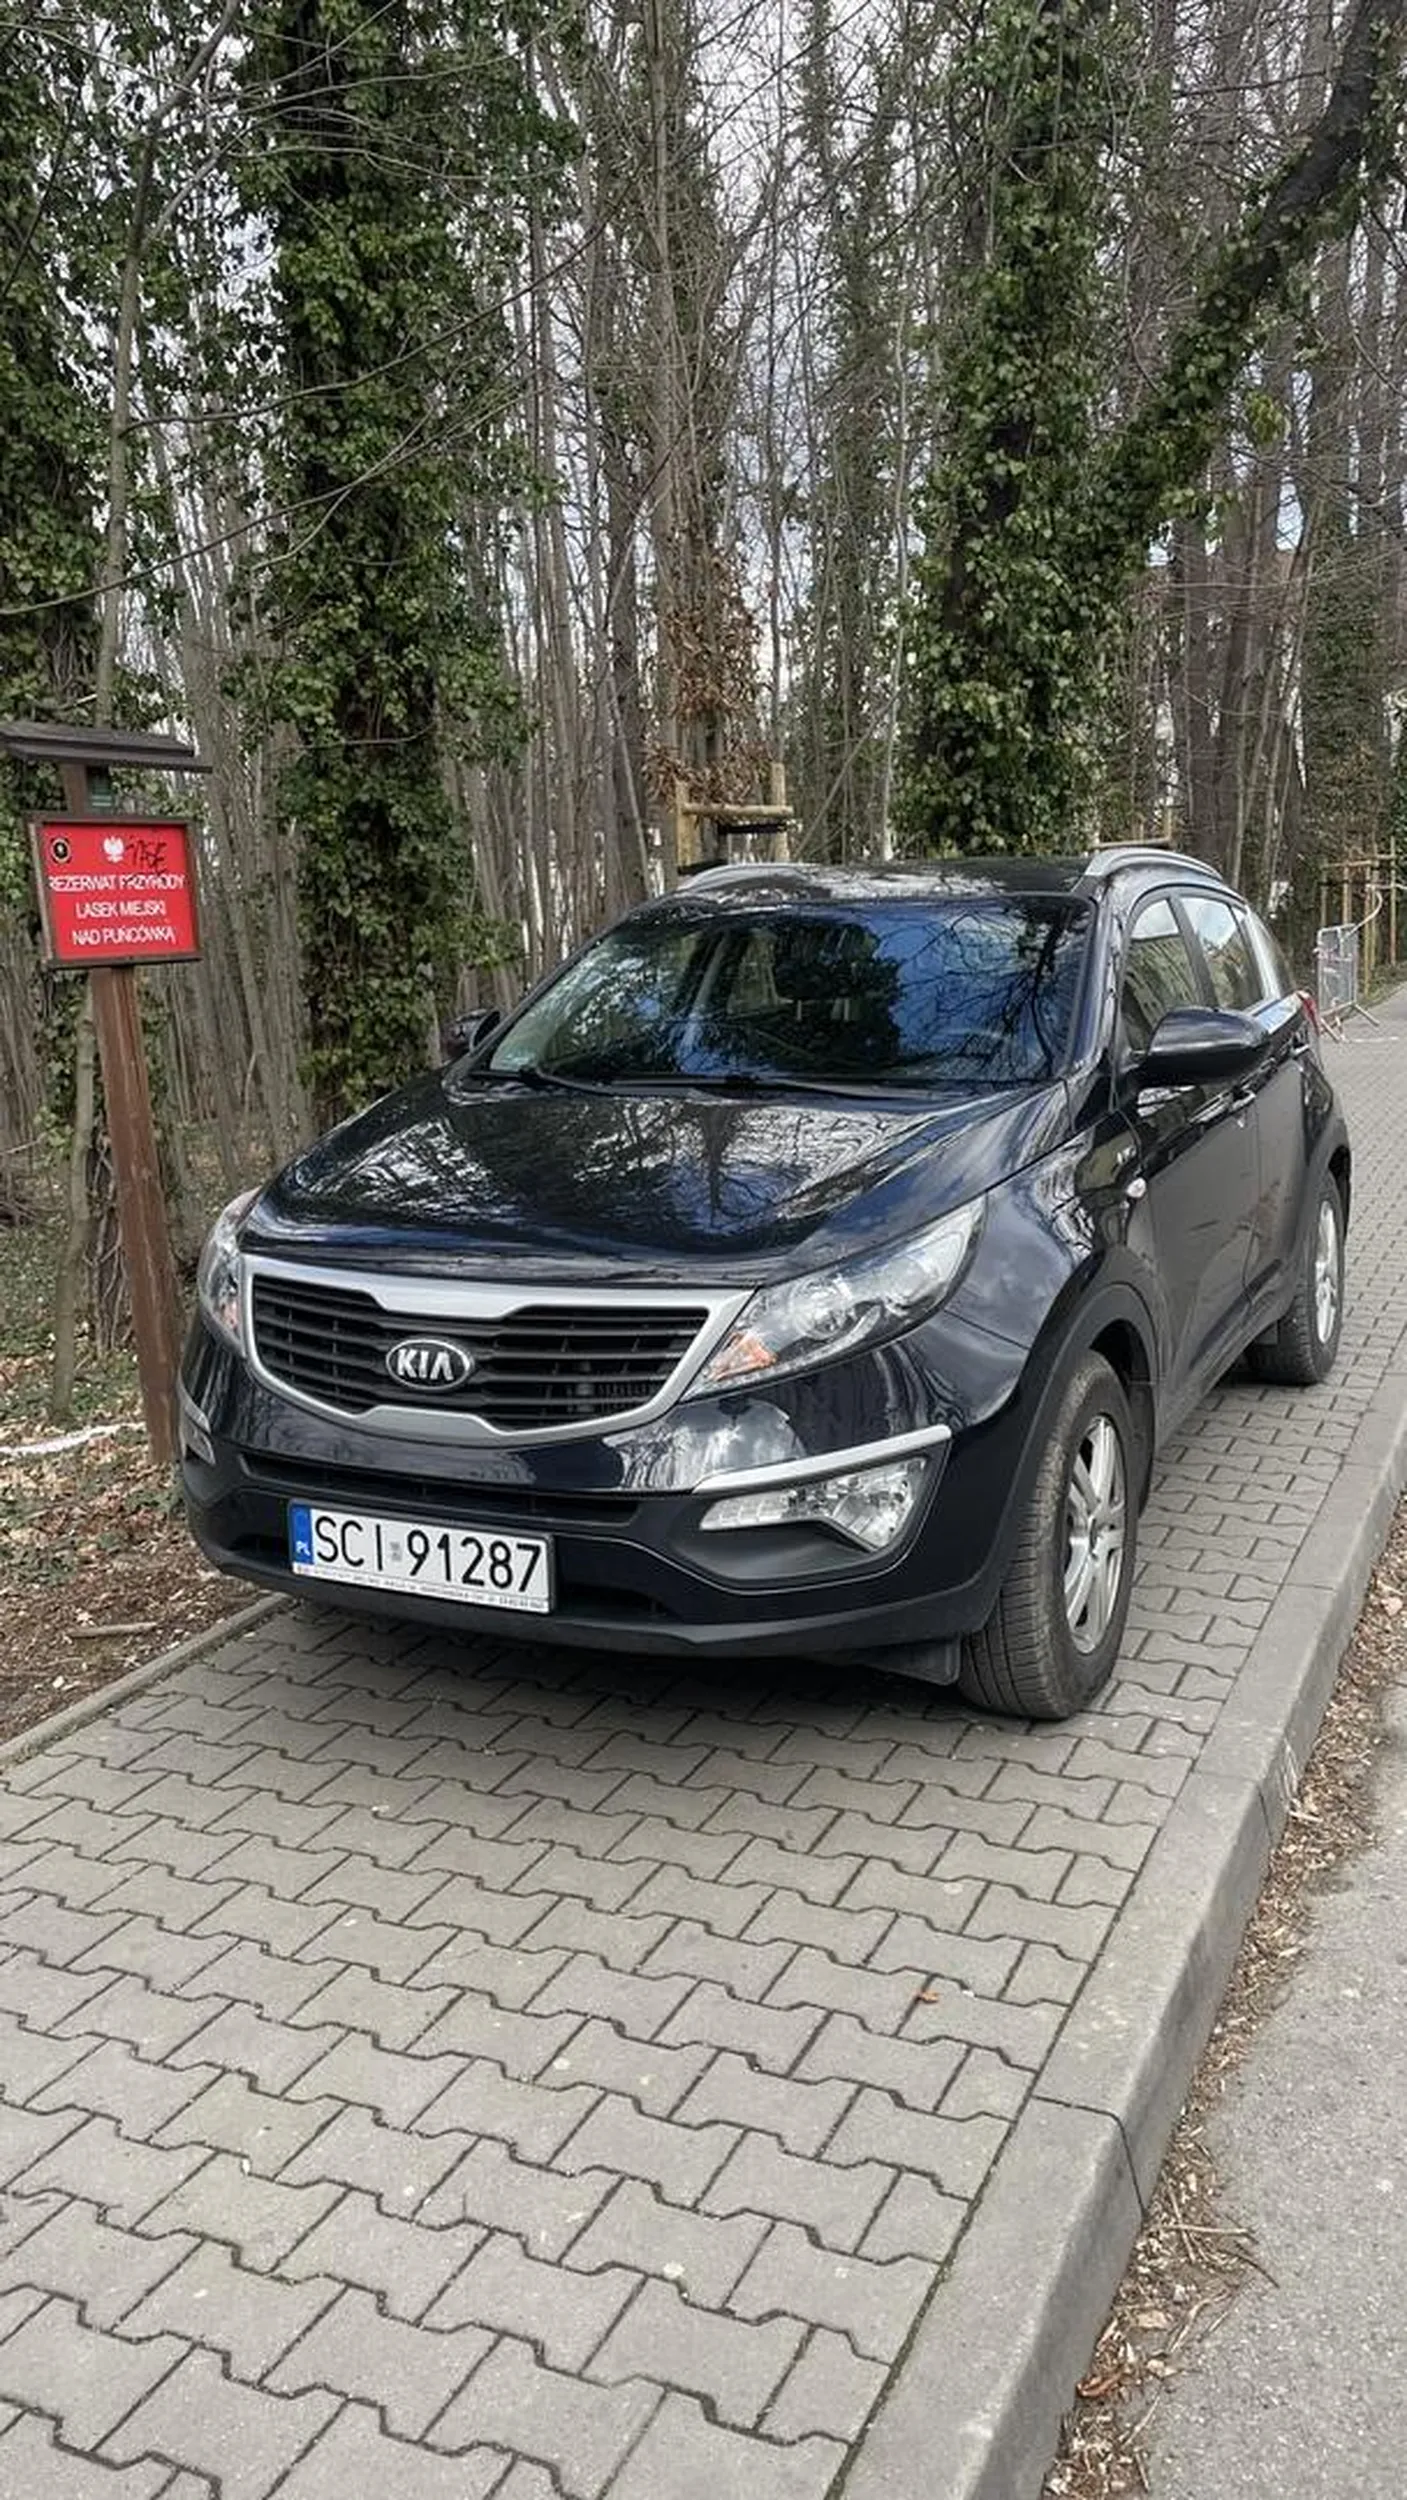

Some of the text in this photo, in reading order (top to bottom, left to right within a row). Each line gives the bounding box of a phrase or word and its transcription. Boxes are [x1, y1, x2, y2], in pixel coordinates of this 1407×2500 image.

[75, 900, 166, 919] LASEK MIEJSKI
[72, 925, 177, 946] NAD PUŃCÓWKĄ
[397, 1348, 454, 1381] KIA
[296, 1540, 311, 1556] PL
[315, 1516, 383, 1571] SCI
[407, 1529, 542, 1593] 91287
